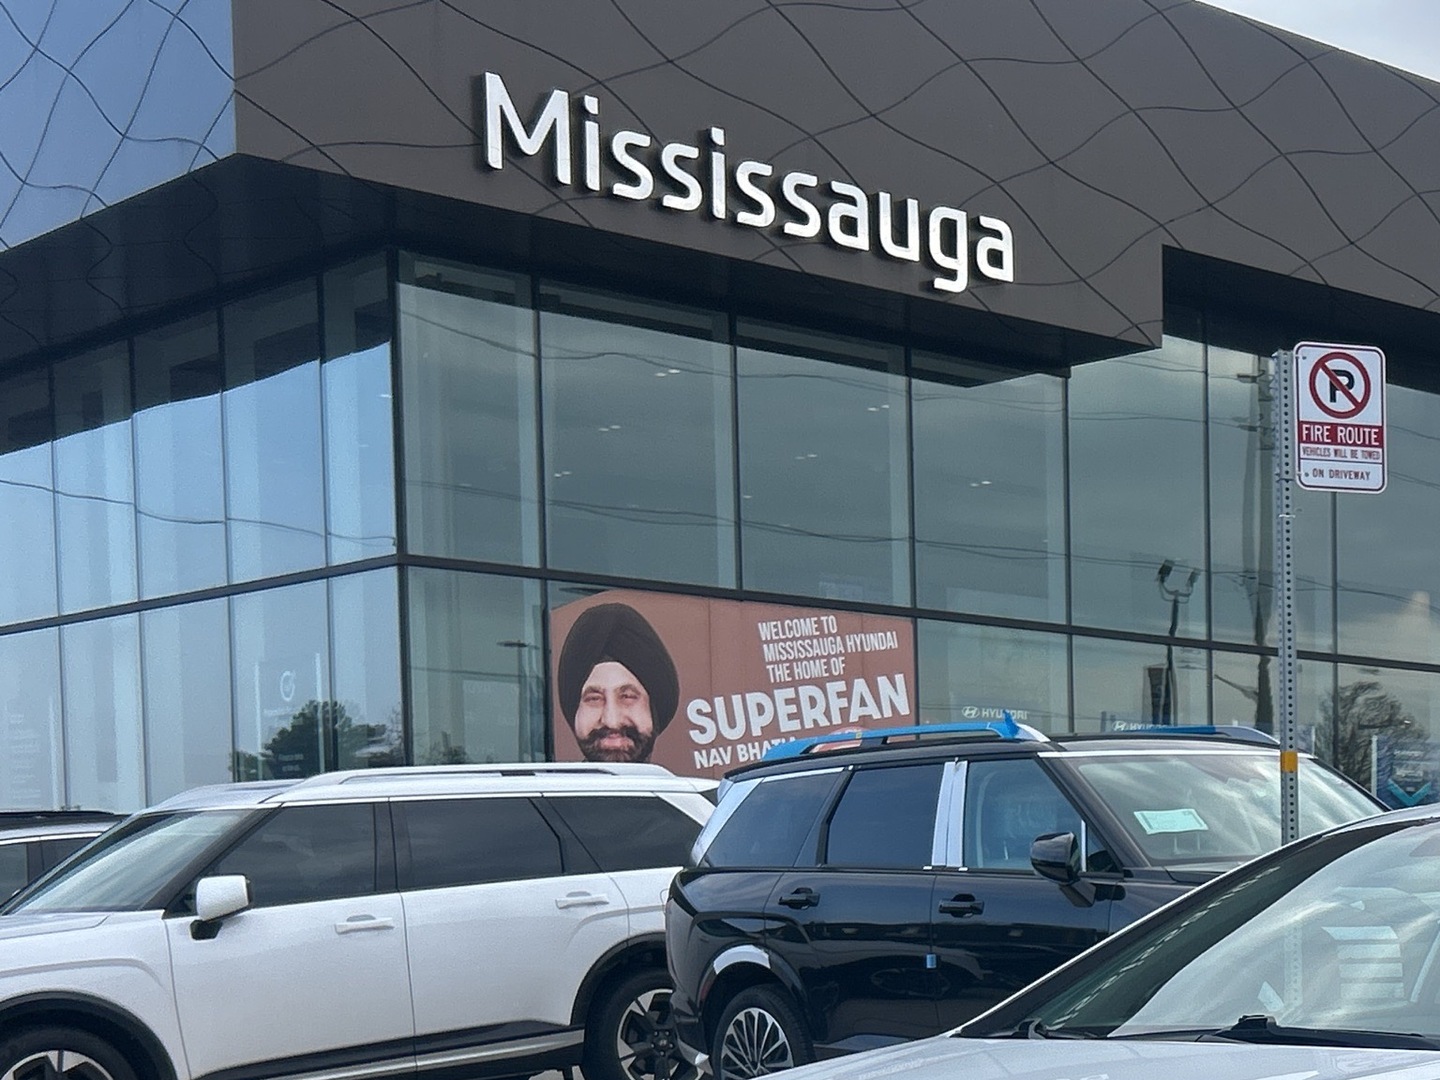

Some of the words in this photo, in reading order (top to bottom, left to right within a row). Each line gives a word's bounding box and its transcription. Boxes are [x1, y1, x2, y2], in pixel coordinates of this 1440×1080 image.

[483, 71, 1015, 293] Mississauga
[1302, 424, 1332, 443] FIRE
[1337, 426, 1380, 446] ROUTE
[1302, 446, 1331, 458] VEHICLES
[1334, 448, 1348, 458] WILL
[1350, 449, 1359, 459] BE
[1361, 450, 1380, 460] TOWED
[1312, 468, 1325, 478] ON
[1328, 468, 1371, 481] DRIVEWAY
[758, 616, 820, 641] WELCOME
[820, 615, 838, 634] TO
[762, 636, 845, 662] MISSISSAUGA
[845, 631, 898, 653] HYUNDAI
[766, 662, 793, 683] THE
[793, 659, 828, 680] HOME
[830, 657, 846, 676] OF
[686, 673, 911, 745] SUPERFAN
[981, 708, 1028, 720] HYUDAI
[693, 745, 732, 769] NAV
